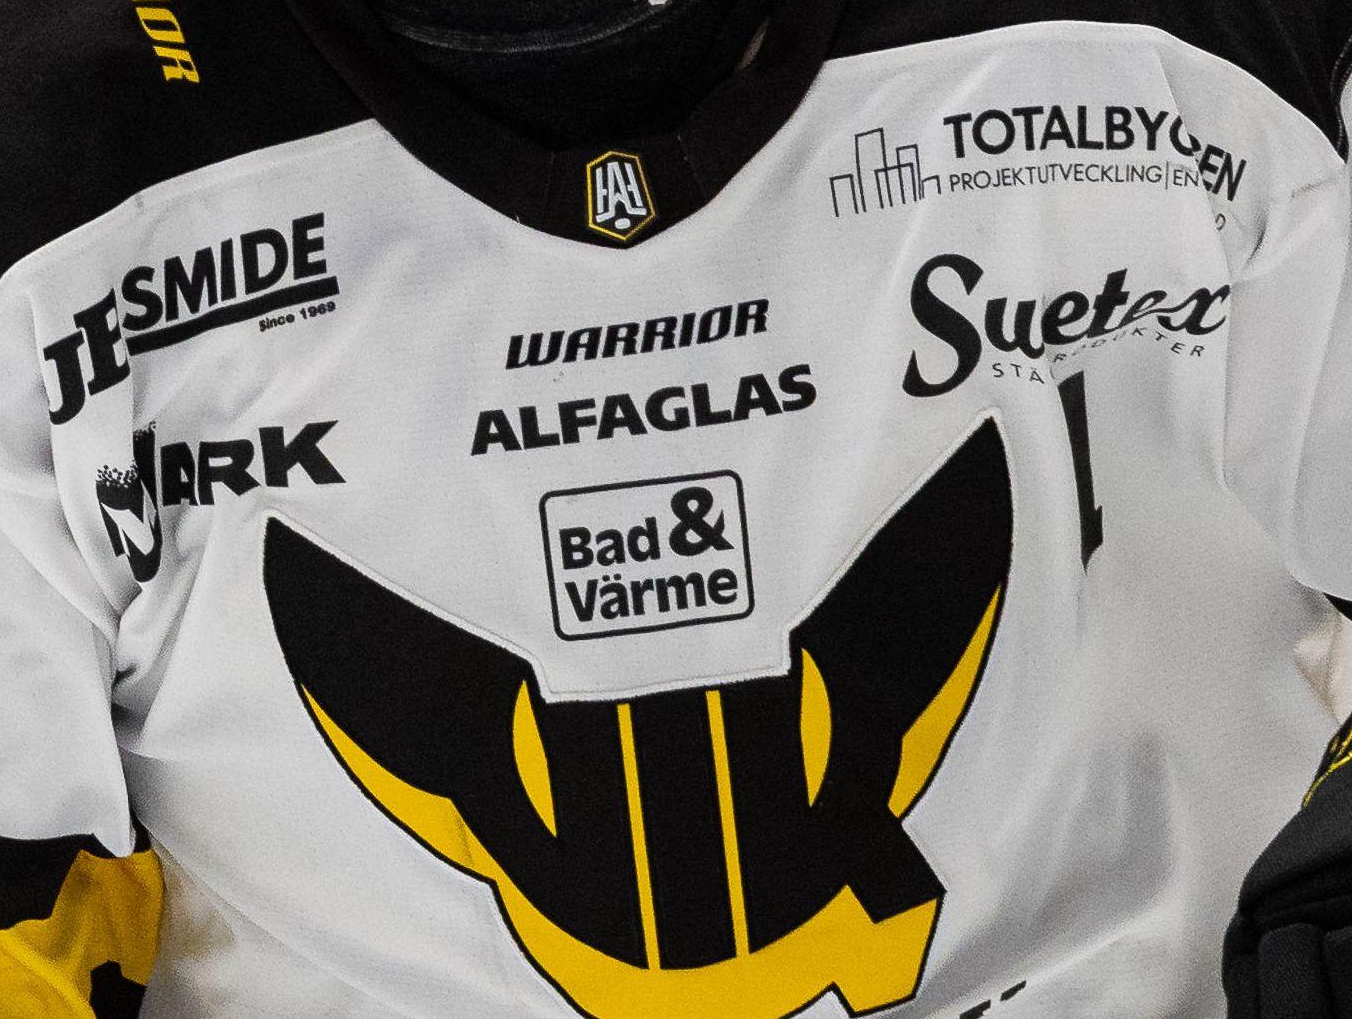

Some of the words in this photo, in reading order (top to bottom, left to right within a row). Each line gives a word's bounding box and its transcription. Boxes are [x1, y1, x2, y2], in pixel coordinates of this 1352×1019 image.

[258, 313, 296, 333] Since
[505, 298, 770, 370] WARRIOR
[902, 252, 1231, 398] Suetex
[470, 364, 818, 457] ALFAGLAS
[558, 516, 662, 570] Bad
[668, 486, 735, 557] &
[564, 567, 739, 623] Värme
